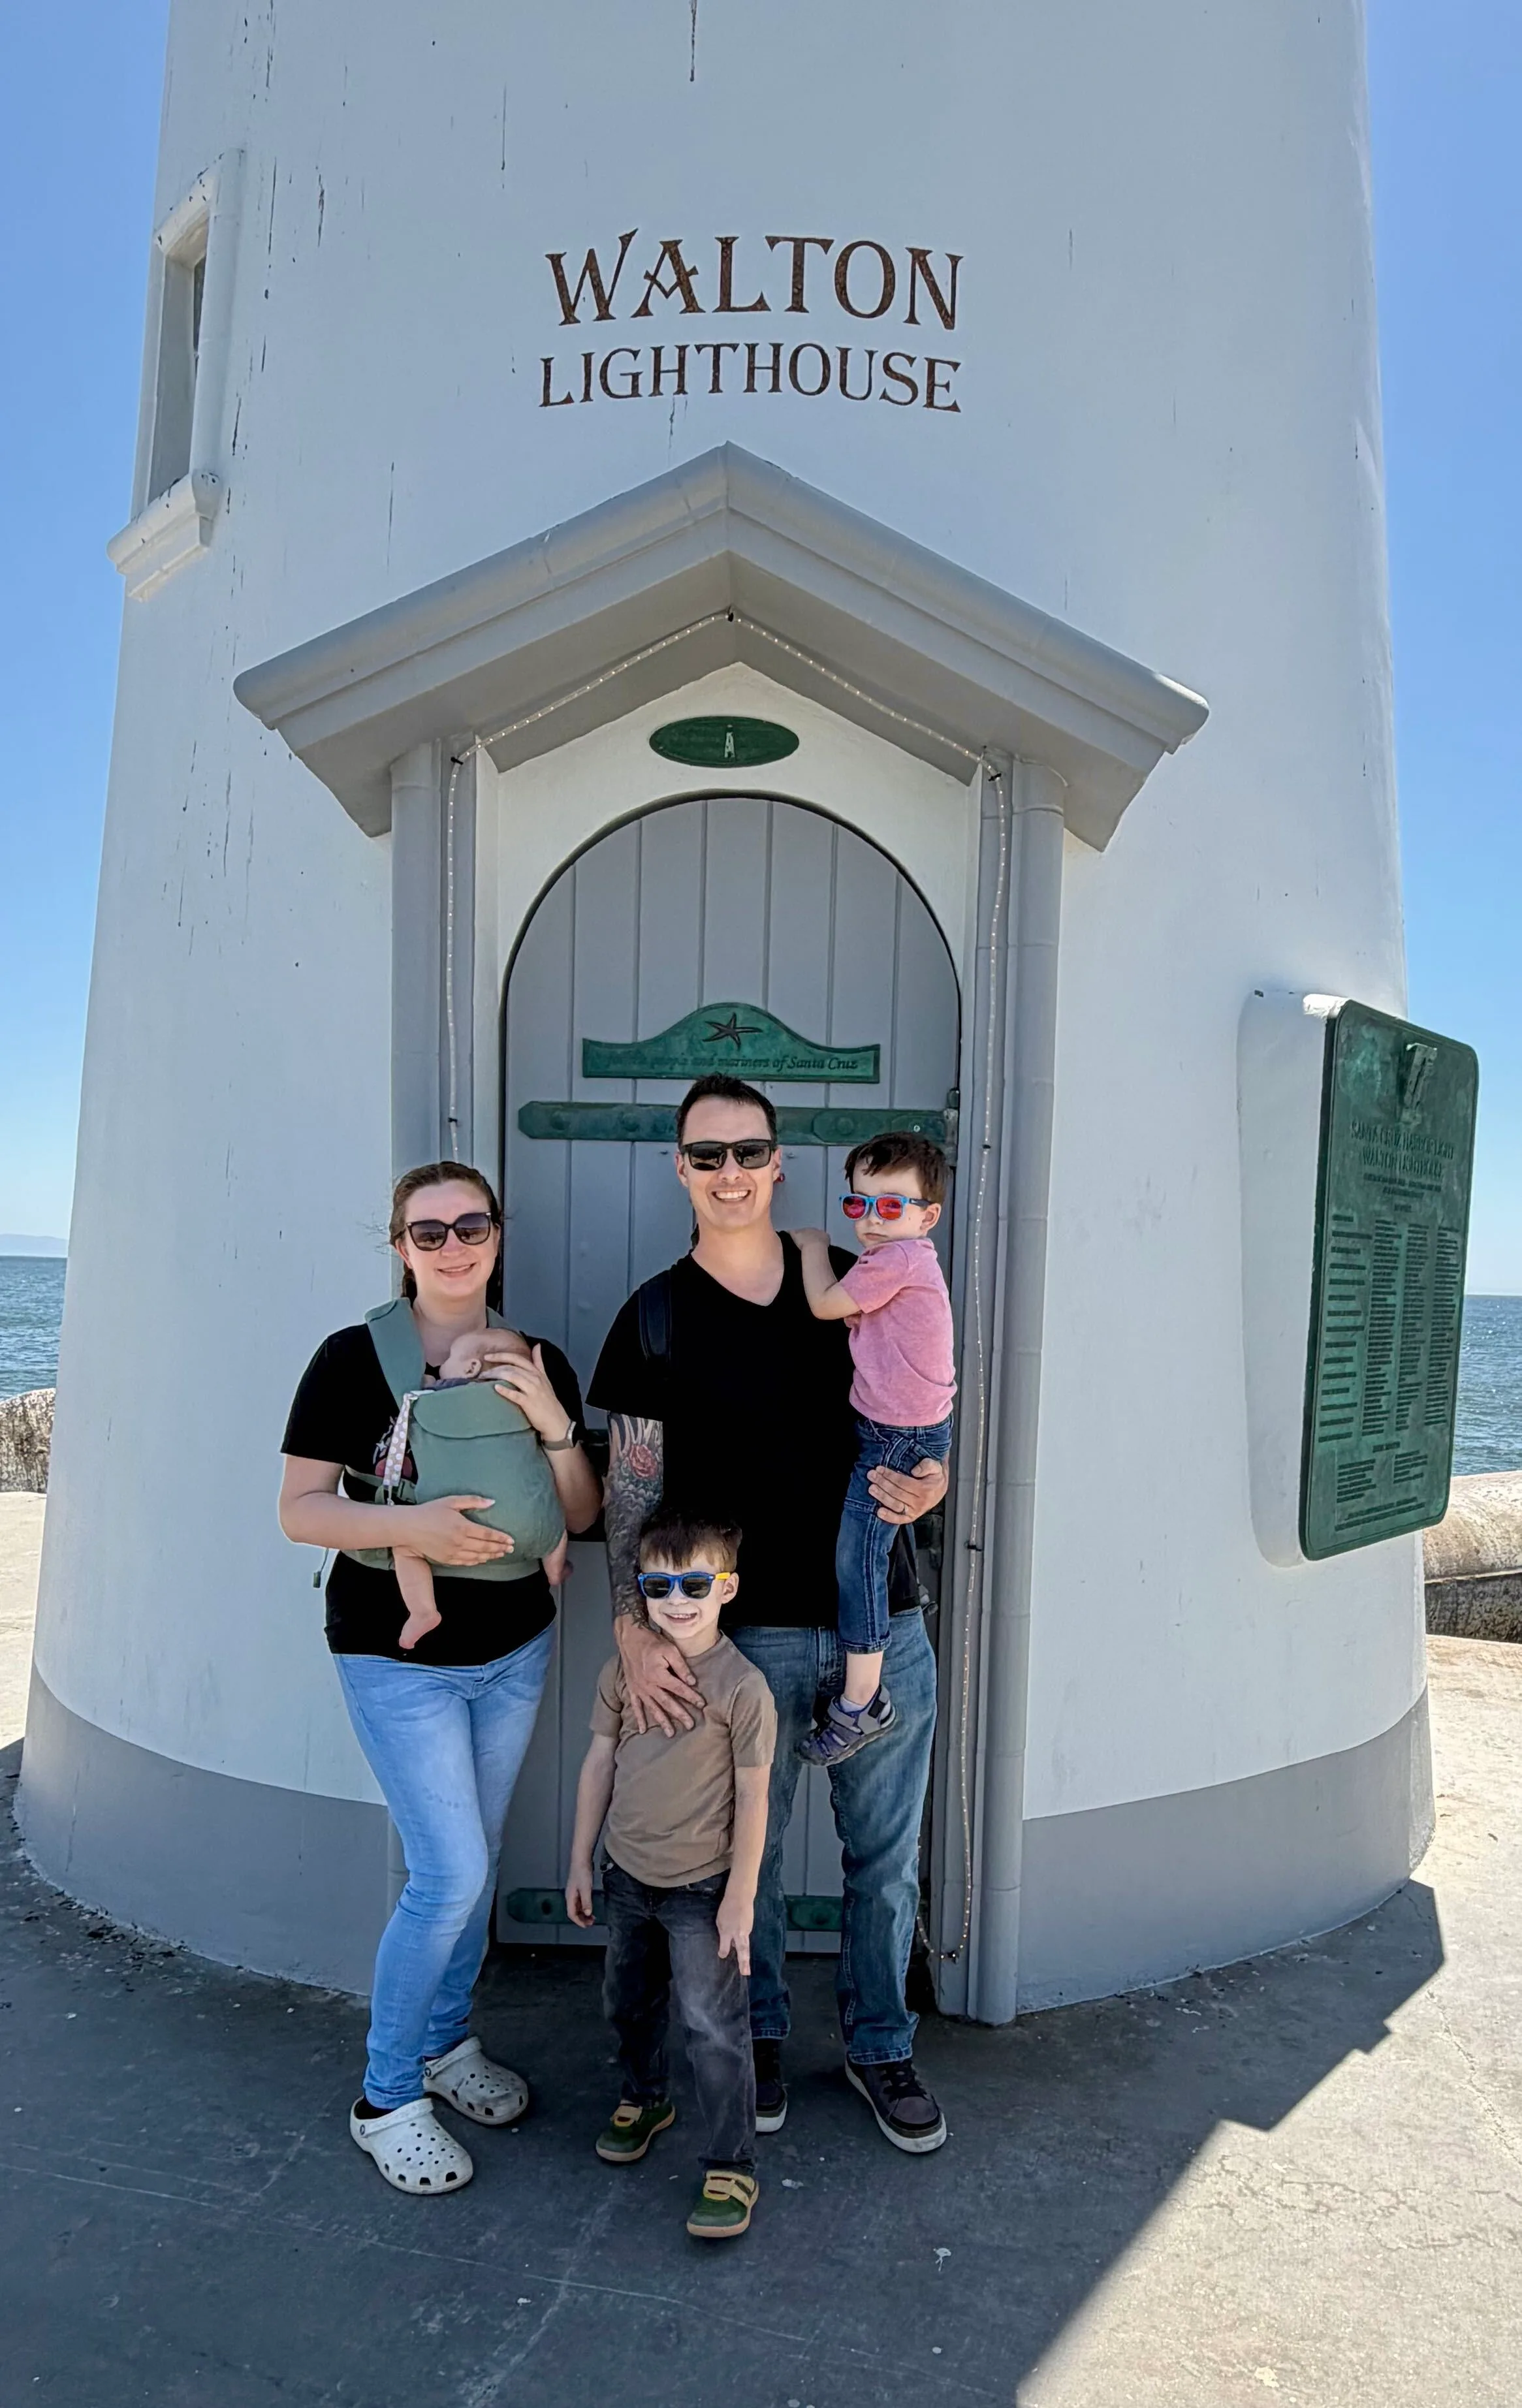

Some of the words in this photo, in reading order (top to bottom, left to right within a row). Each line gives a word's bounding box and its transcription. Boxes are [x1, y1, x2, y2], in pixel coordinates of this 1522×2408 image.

[545, 228, 963, 330] WALTON
[539, 342, 961, 413] LIGHTHOUSE
[772, 1054, 788, 1071] of
[787, 1054, 825, 1069] Santa
[827, 1057, 858, 1070] Cruz
